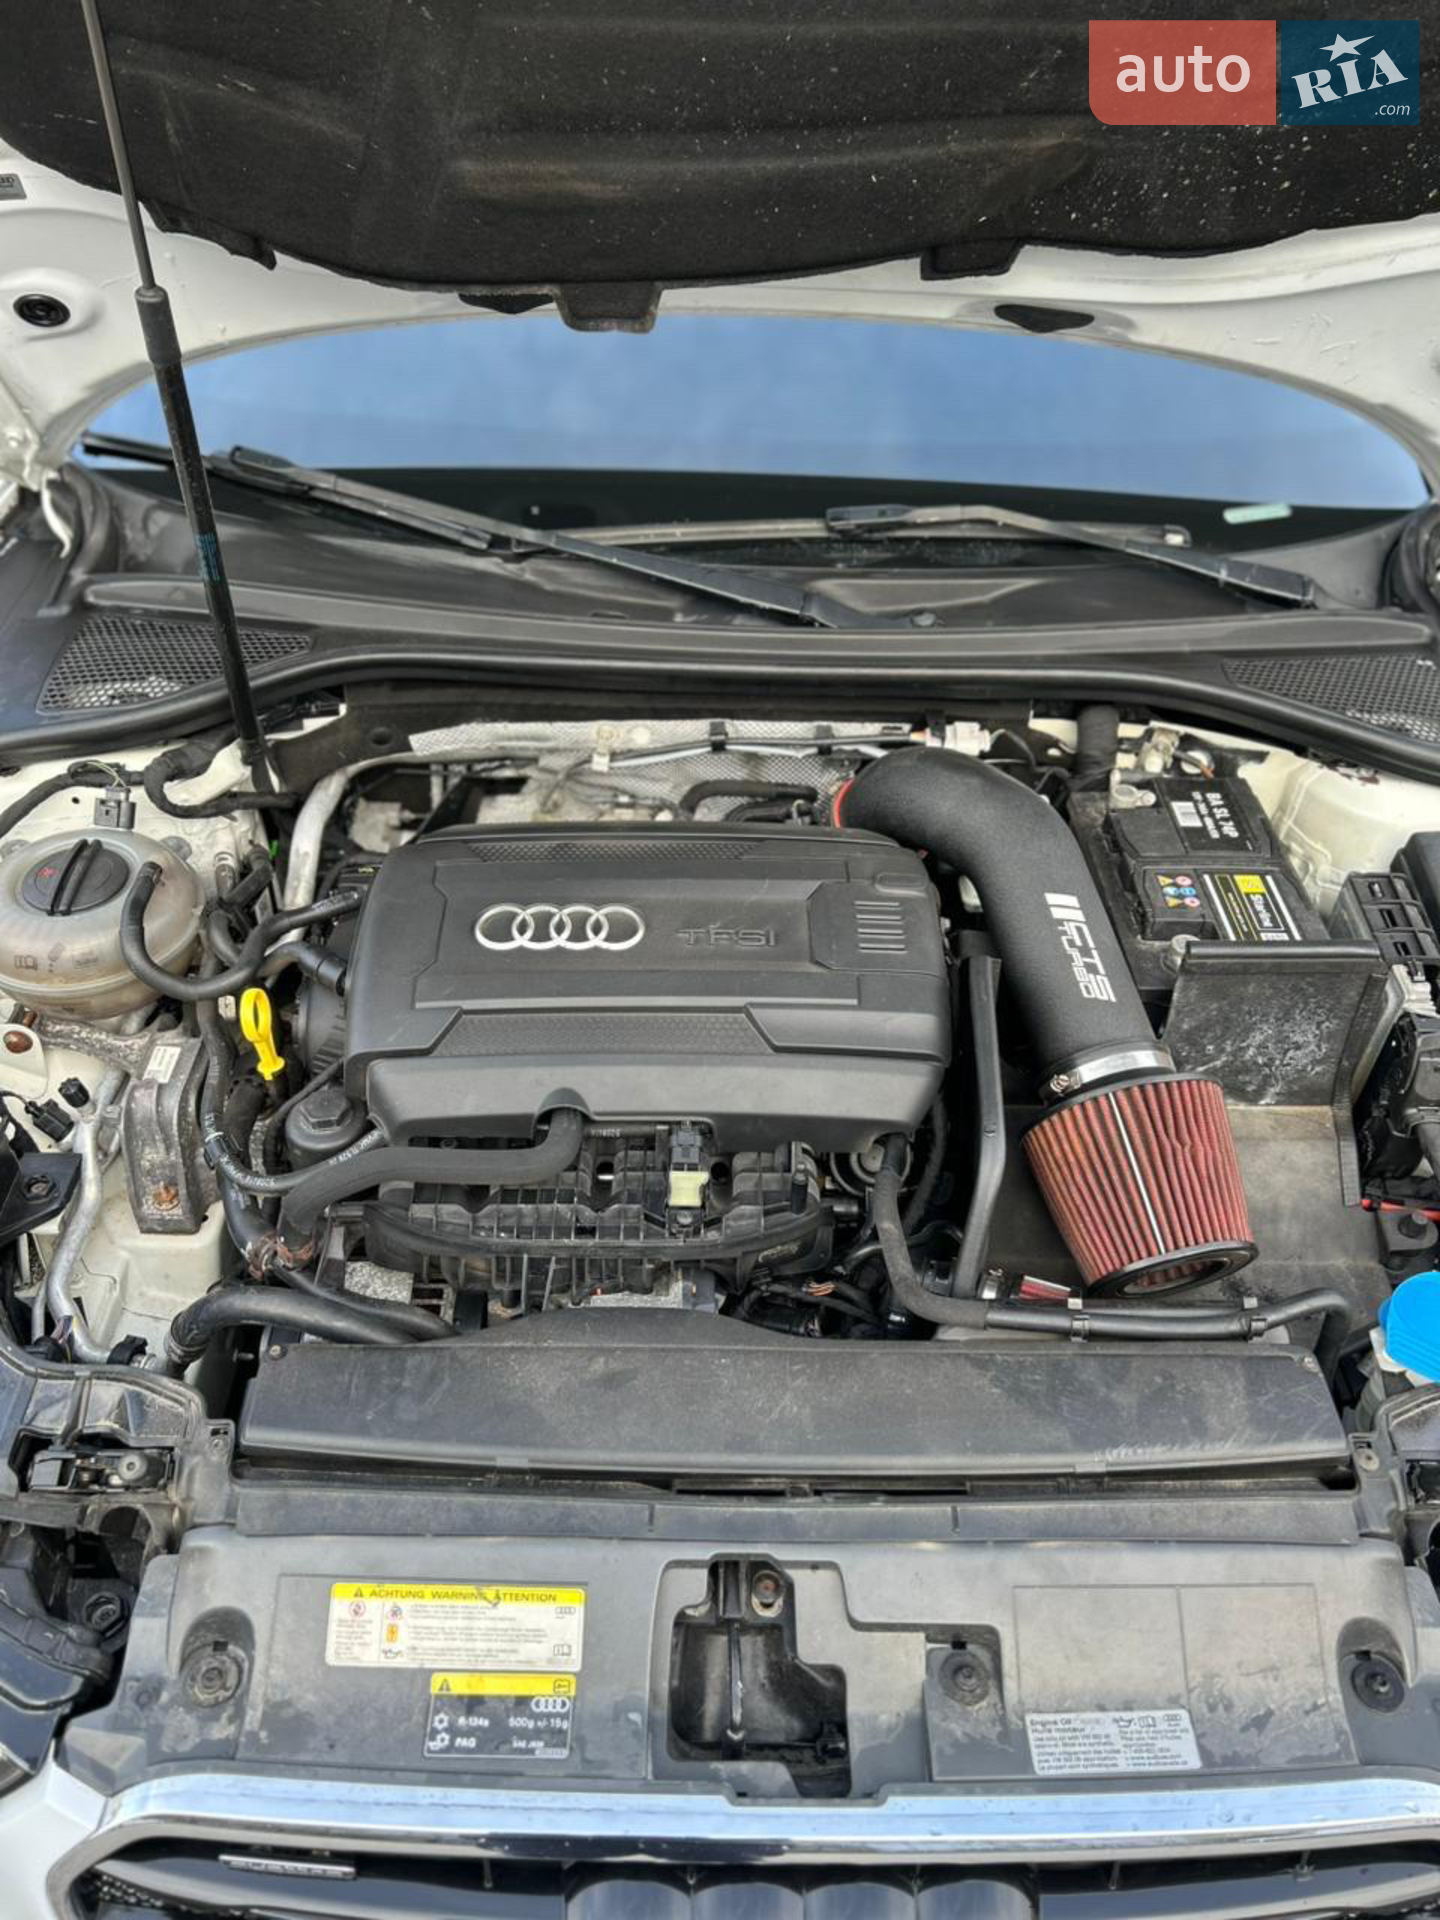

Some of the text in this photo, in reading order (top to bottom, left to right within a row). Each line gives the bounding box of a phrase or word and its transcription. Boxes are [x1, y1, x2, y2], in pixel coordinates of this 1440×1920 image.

[676, 927, 776, 947] TFSI
[1057, 920, 1096, 999] TURBO
[1066, 921, 1117, 1003] CTS
[369, 1589, 557, 1603] ACHTUNG WARNING ATTENTION
[457, 1716, 490, 1728] R-134a
[508, 1716, 535, 1729] 500g
[1030, 1718, 1058, 1728] Engine
[455, 1737, 477, 1749] PAG
